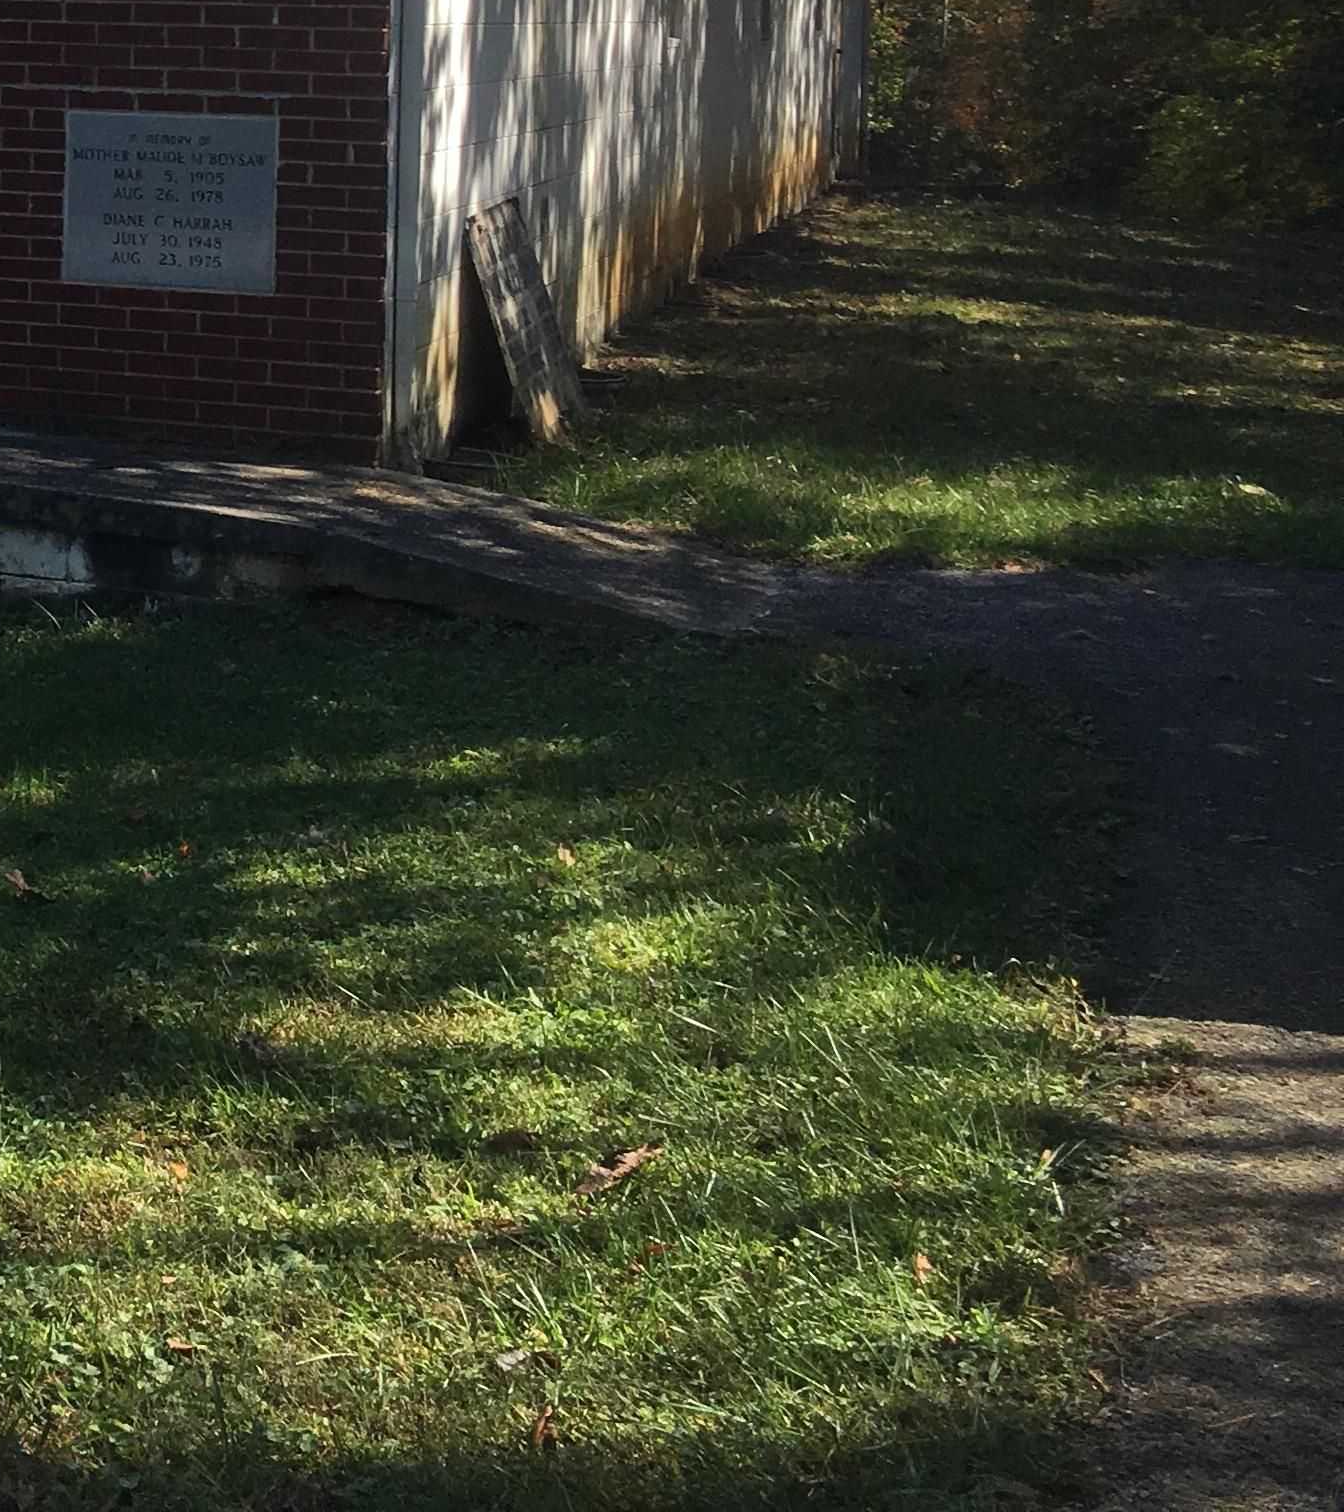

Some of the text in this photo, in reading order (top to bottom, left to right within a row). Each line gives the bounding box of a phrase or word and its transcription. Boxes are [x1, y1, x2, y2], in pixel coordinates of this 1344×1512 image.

[72, 148, 129, 162] MOTHER
[136, 150, 186, 165] MAUDE
[208, 153, 267, 167] BOYSAW
[190, 171, 225, 185] 1905
[191, 190, 224, 204] 1978
[103, 212, 145, 227] DIANE
[173, 216, 233, 231] HARRAH
[111, 231, 149, 246] JULY
[188, 236, 223, 250] 1948
[189, 254, 222, 269] 1975
